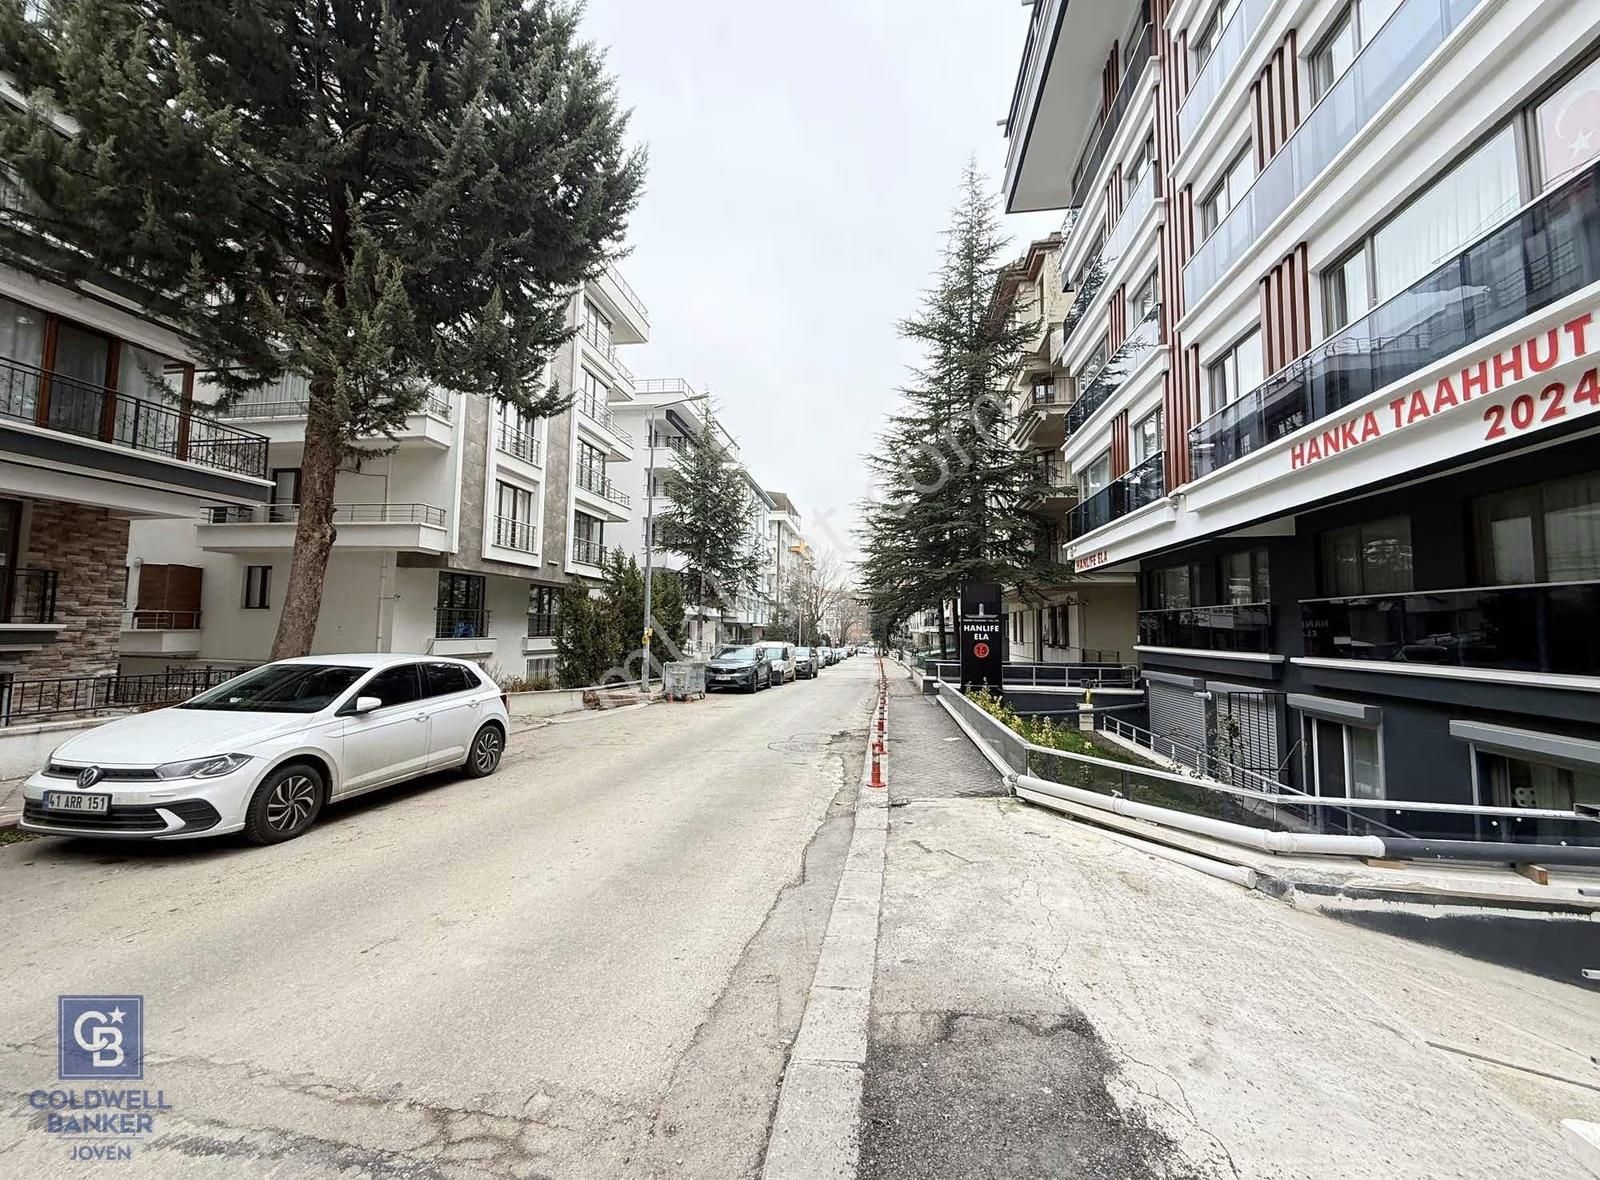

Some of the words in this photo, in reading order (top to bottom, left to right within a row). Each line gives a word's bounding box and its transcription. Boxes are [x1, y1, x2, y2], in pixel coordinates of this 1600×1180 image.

[1291, 411, 1381, 470] HANKA
[1390, 312, 1592, 429] TAAHHUT
[1483, 366, 1600, 441] 2024
[1076, 553, 1097, 570] HANLIFE
[1097, 550, 1108, 565] ELA
[963, 624, 1000, 632] HANLIFE
[50, 794, 61, 807] 41
[64, 795, 83, 809] ARR
[88, 796, 105, 810] 151
